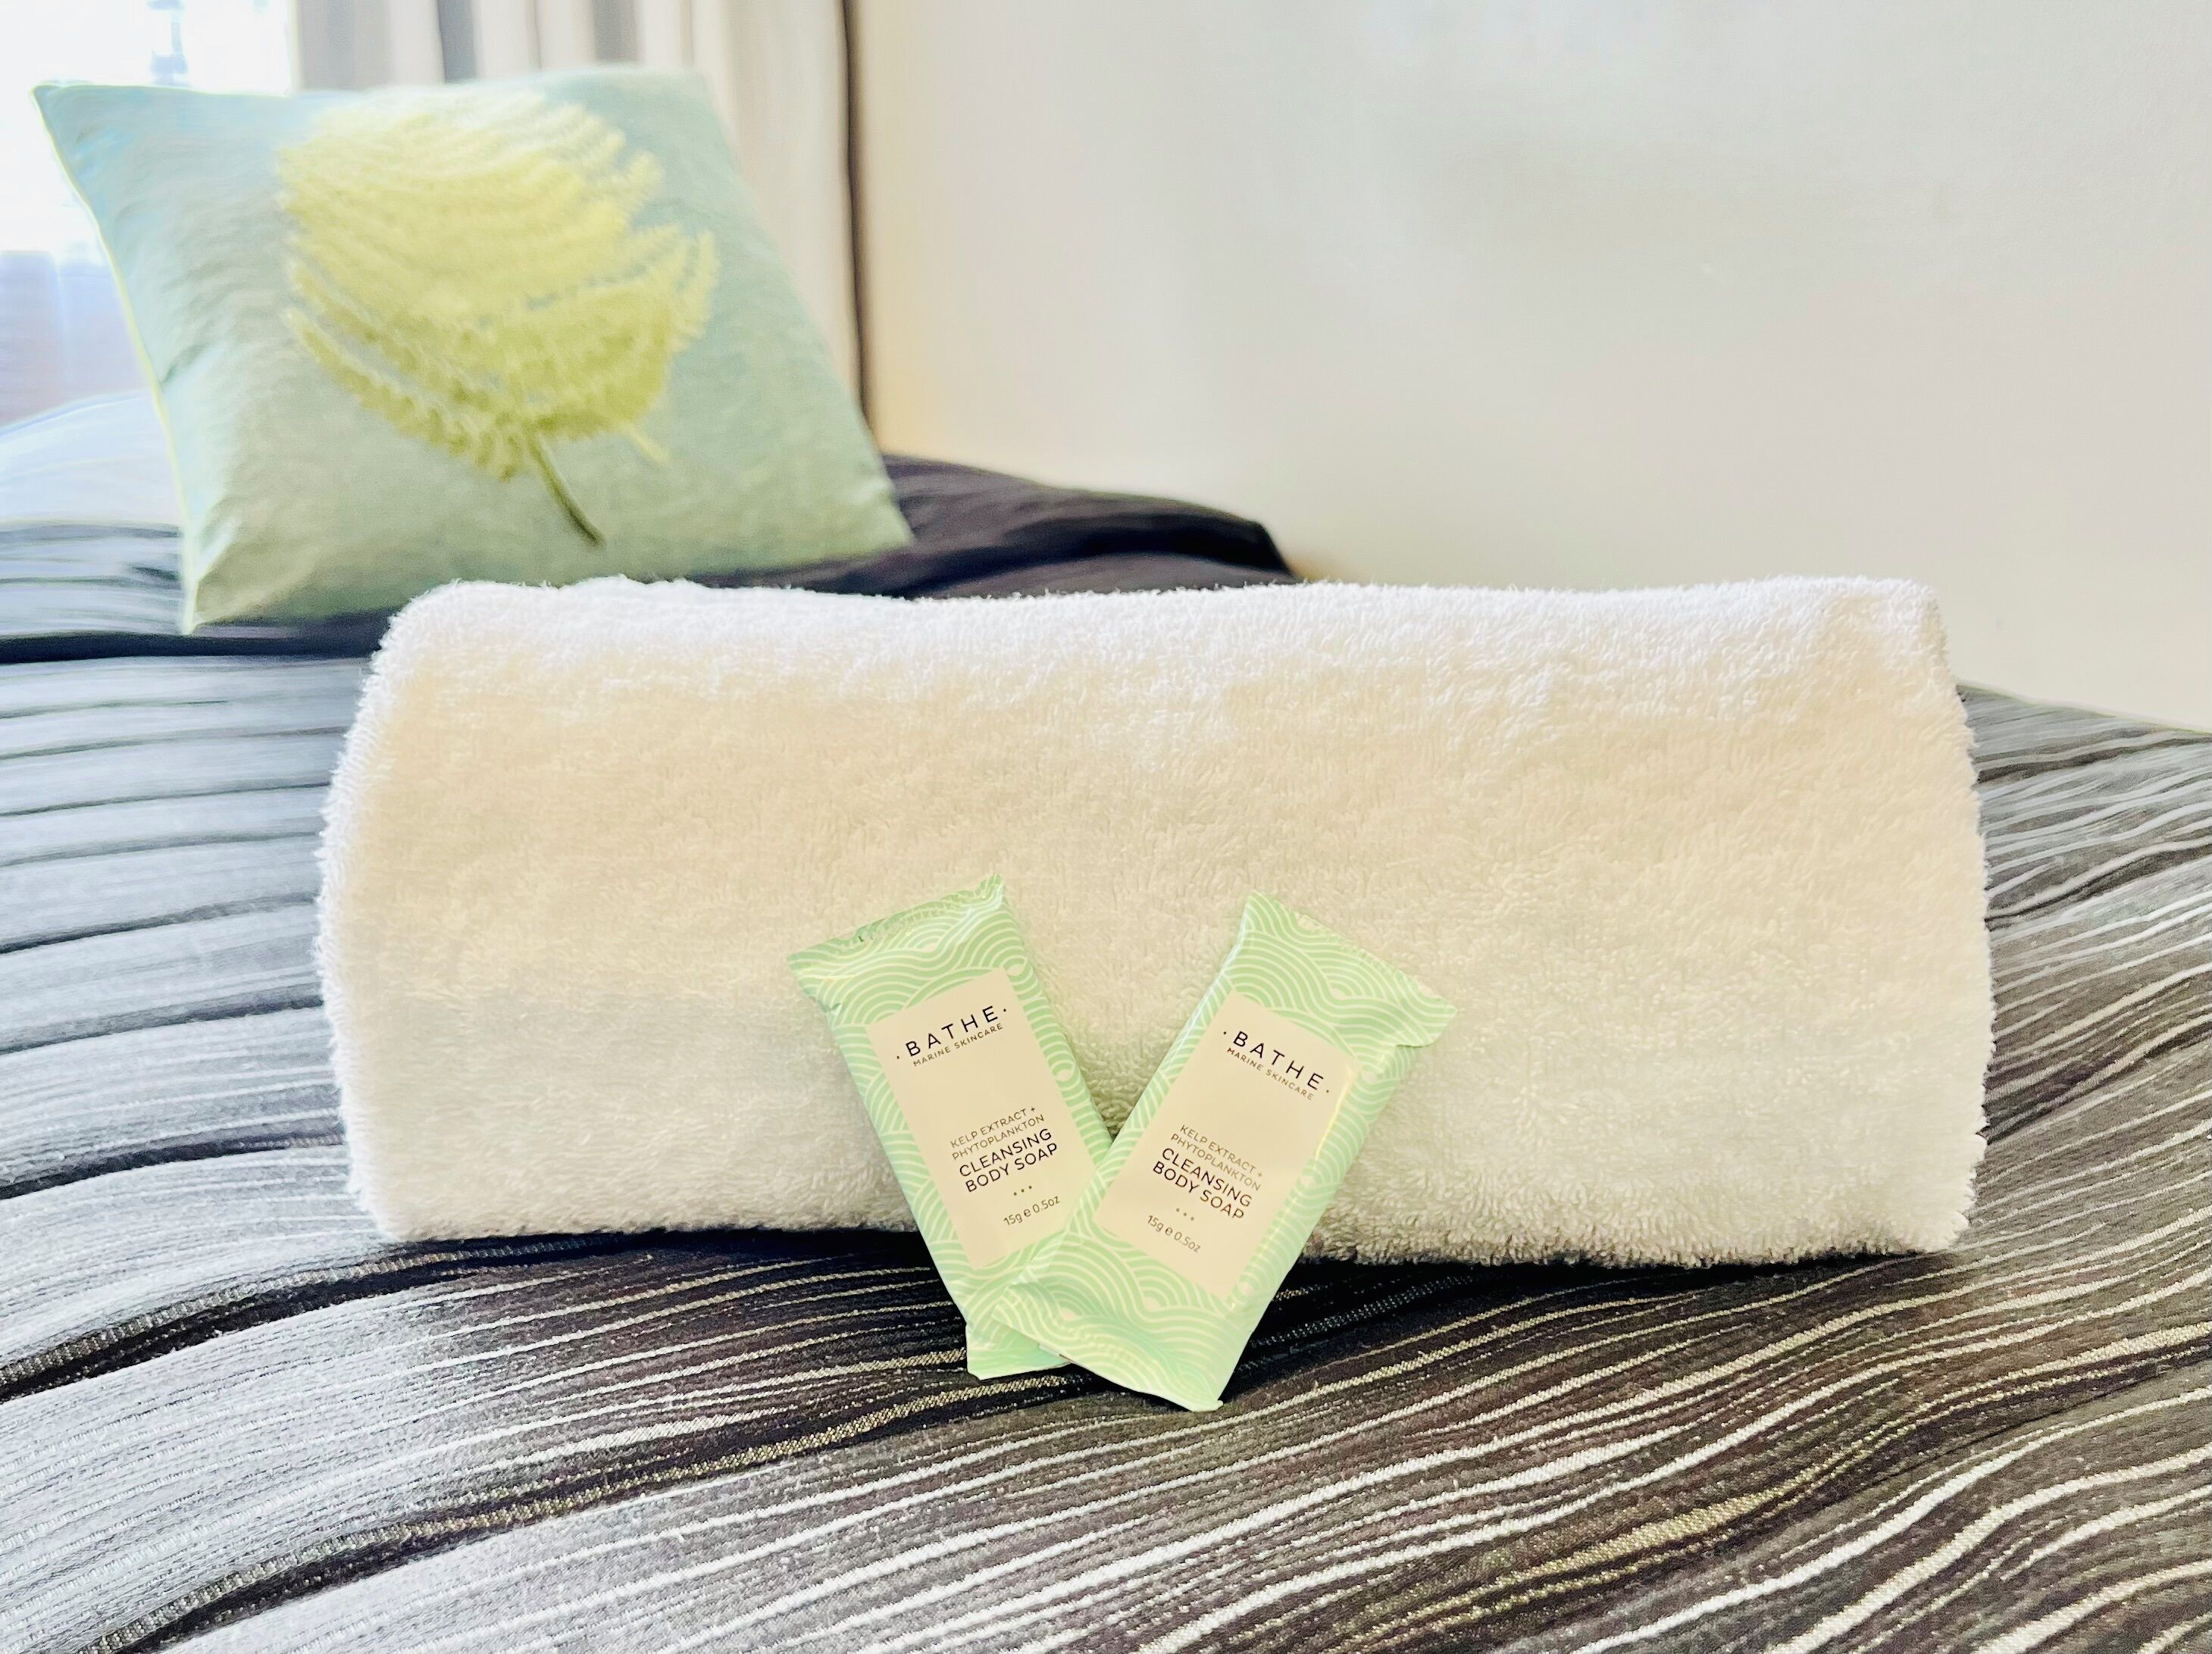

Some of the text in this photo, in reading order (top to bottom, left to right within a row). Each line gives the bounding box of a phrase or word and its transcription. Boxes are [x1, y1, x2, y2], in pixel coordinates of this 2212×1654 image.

[906, 1005, 998, 1056] BATHE
[913, 1023, 1003, 1067] MARINE SKINCARE
[1227, 1047, 1314, 1101] MARINE SKINCARE
[1233, 1030, 1324, 1090] BATHE
[950, 1130, 978, 1149] KELP
[980, 1108, 1026, 1135] EXTRACT
[952, 1114, 1044, 1161] PHYTOPLANKTON
[959, 1128, 1052, 1177] CLEANSING
[1180, 1124, 1207, 1143] KELP
[1208, 1141, 1256, 1173] EXTRACT
[965, 1143, 1057, 1193] BODY SOAP
[1162, 1148, 1252, 1207] CLEANSING
[1171, 1133, 1261, 1191] PHYTOPLANKTON
[1003, 1213, 1023, 1226] 15g
[1032, 1196, 1060, 1214] 0.5oz
[1153, 1161, 1244, 1219] BODY SOAP
[1147, 1215, 1164, 1233] 15g
[1174, 1231, 1201, 1252] 0.5oz
